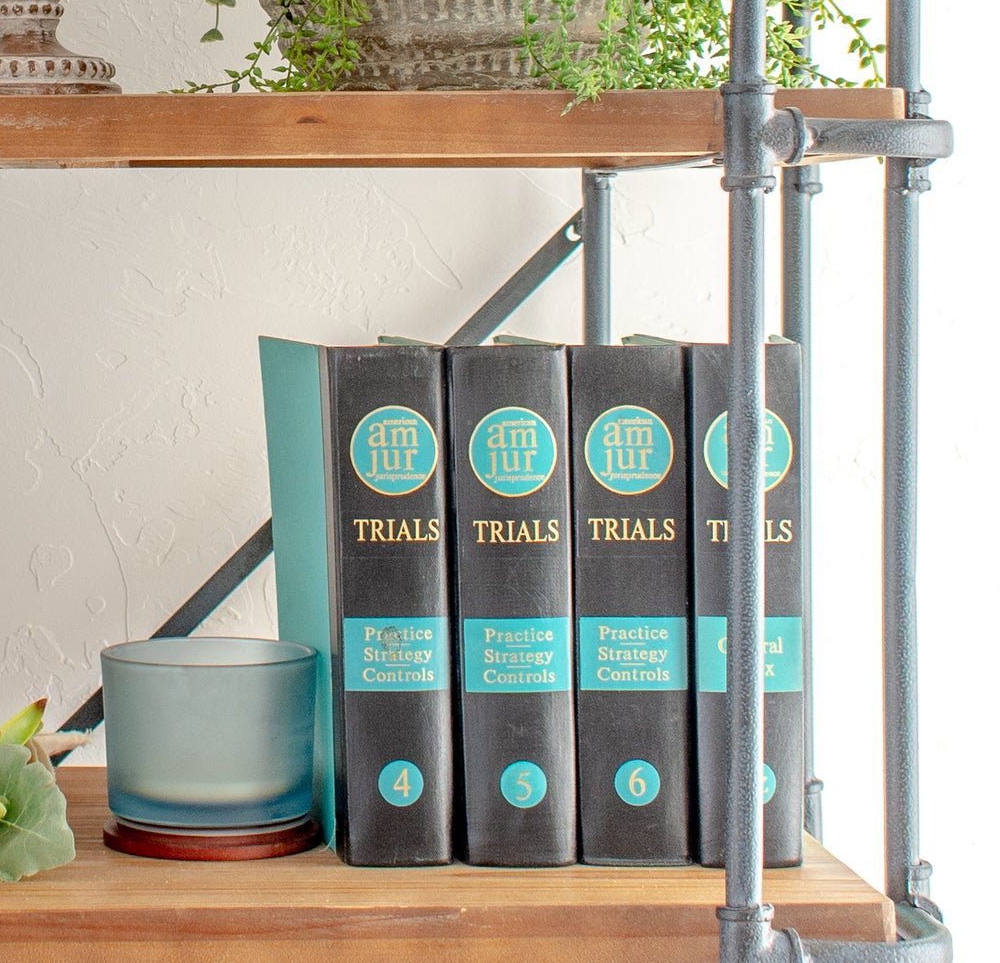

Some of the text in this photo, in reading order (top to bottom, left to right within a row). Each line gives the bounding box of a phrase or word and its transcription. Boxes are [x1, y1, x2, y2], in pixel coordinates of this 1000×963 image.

[367, 422, 418, 448] am
[487, 423, 537, 449] am
[602, 422, 653, 447] am
[365, 448, 418, 477] jur
[485, 449, 537, 478] jur
[600, 448, 653, 477] jur
[353, 518, 440, 542] TRIALS
[472, 519, 560, 543] TRIALS
[587, 517, 676, 542] TRIALS
[706, 519, 793, 543] TLS
[484, 627, 554, 644] Practice
[598, 625, 669, 640] Practice
[364, 647, 433, 664] Strategy
[484, 648, 553, 665] Strategy
[598, 646, 668, 663] Strategy
[362, 667, 435, 683] Controls
[483, 669, 556, 684] Controls
[596, 666, 670, 682] Controls
[393, 769, 411, 798] 4
[516, 771, 532, 801] 5
[628, 767, 646, 797] 6
